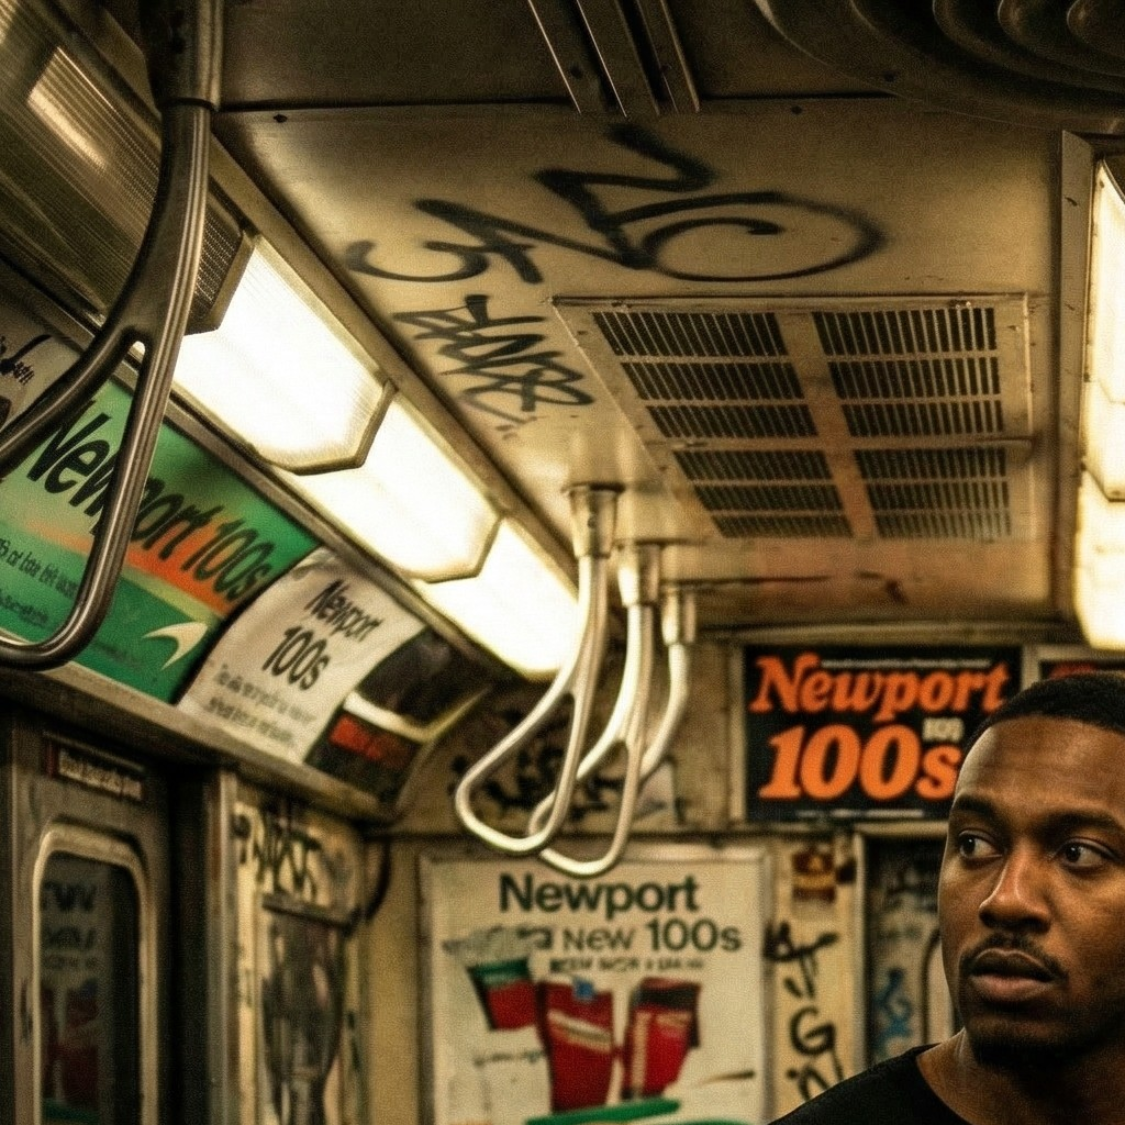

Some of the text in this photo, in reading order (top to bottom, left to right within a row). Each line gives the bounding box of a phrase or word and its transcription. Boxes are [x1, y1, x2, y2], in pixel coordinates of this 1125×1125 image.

[181, 520, 276, 602] 100s
[304, 578, 383, 643] Newport
[262, 625, 330, 691] 100s
[750, 652, 1010, 723] Newport
[758, 723, 963, 800] 100s
[500, 872, 700, 921] Newport
[647, 917, 742, 952] 100s
